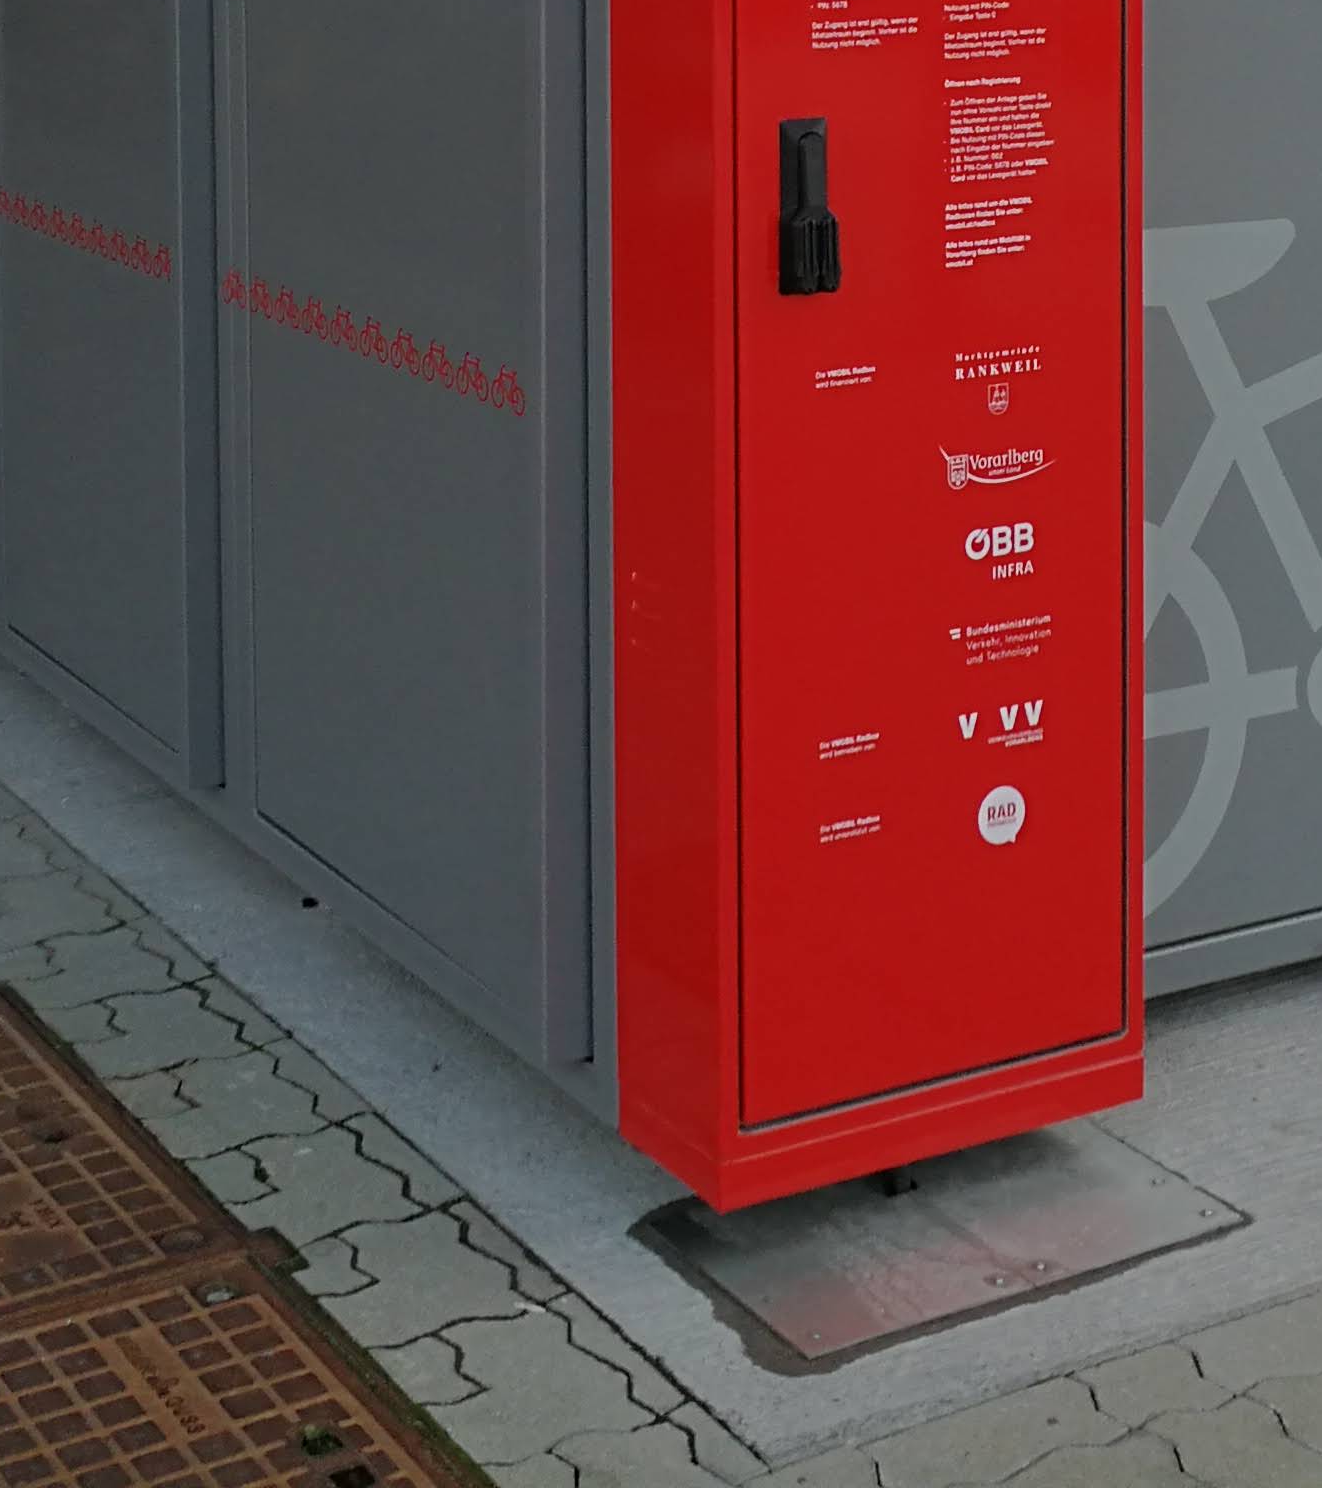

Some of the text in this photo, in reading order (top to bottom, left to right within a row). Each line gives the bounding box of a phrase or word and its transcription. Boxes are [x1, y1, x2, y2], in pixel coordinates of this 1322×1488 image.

[955, 345, 1040, 362] Marktgemeinde
[955, 358, 1041, 380] RANKWEIL
[970, 449, 1044, 470] Vorarlberg
[965, 522, 1034, 560] ÖBB
[992, 559, 1034, 580] INFRA
[966, 615, 1052, 637] Bundesministerium
[966, 629, 1052, 651] Verkehr, Innovation
[966, 644, 1039, 665] und Technologie
[988, 802, 1016, 822] RAD
